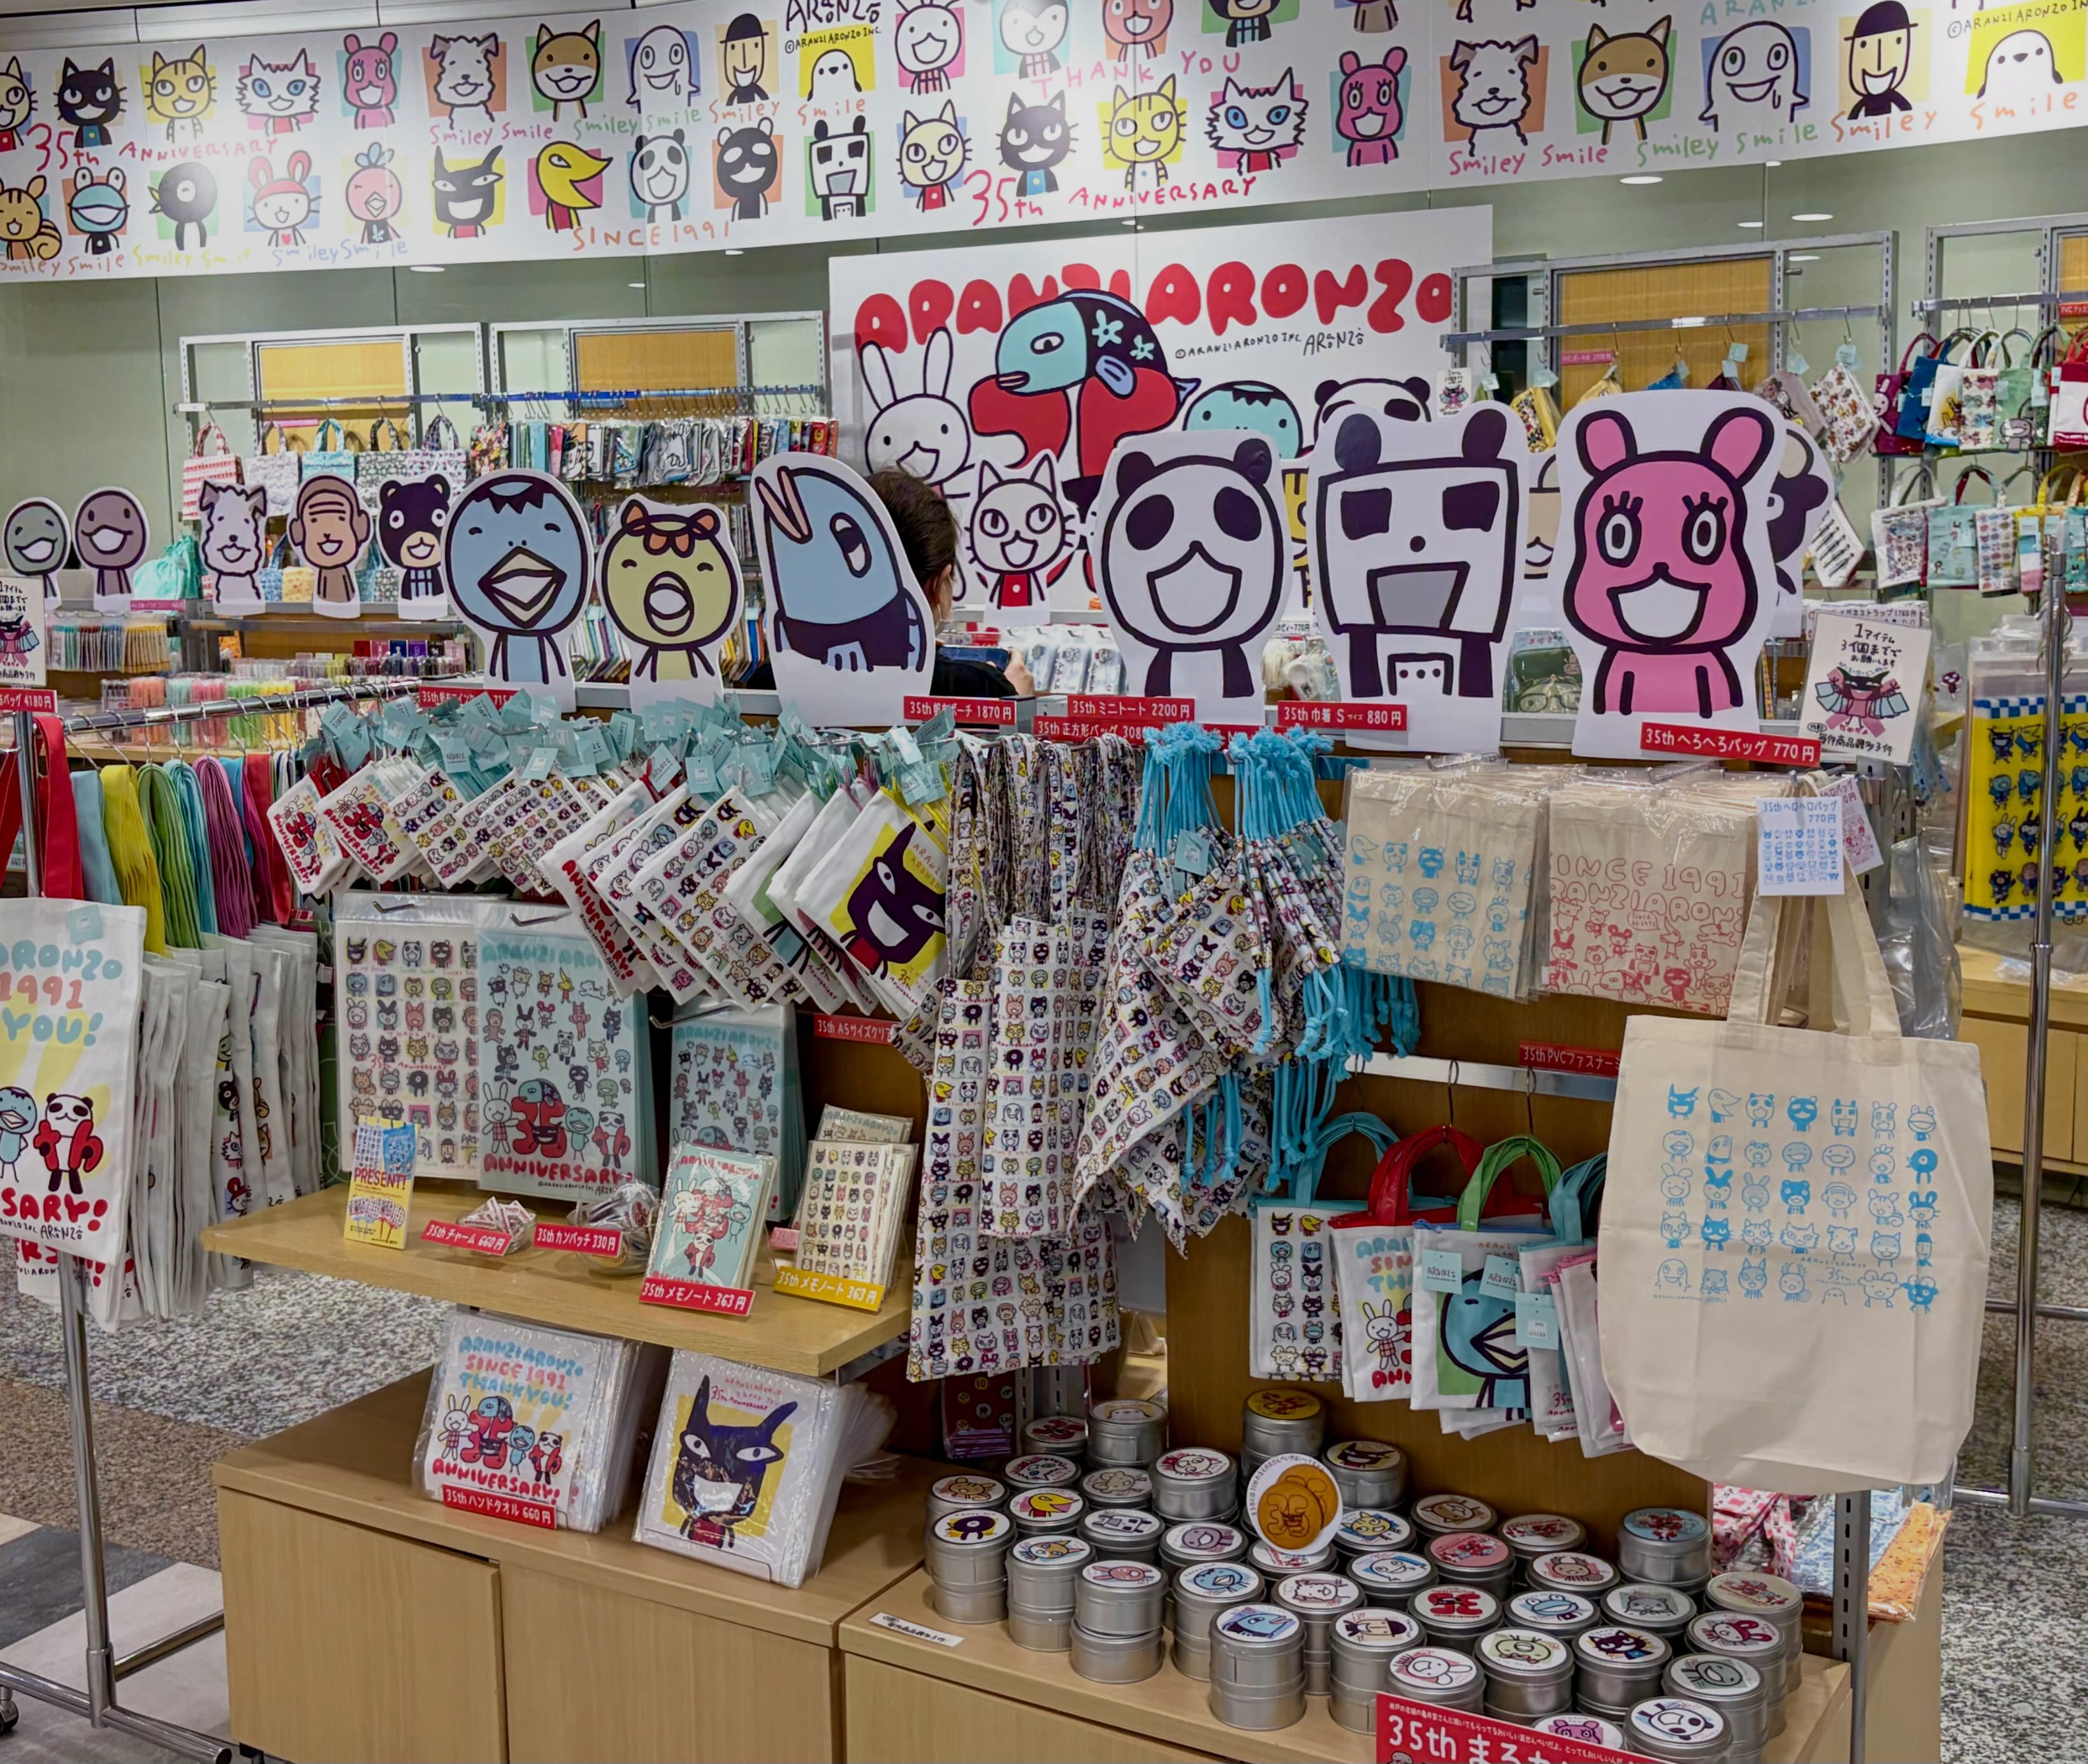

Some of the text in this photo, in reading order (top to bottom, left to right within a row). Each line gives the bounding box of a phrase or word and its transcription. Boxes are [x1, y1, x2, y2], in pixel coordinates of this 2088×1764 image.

[1031, 64, 1154, 99] THANK
[574, 107, 702, 140] Smiley Smile
[709, 98, 866, 126] Smiley Smile
[1831, 91, 2077, 142] Smiley Smile
[430, 122, 553, 146] Smiley Smile
[1637, 121, 1818, 167] Smiley Smile
[26, 123, 278, 172] 35th ANNIVERSARY
[1449, 145, 1608, 177] Smiley Smile
[964, 170, 1256, 226] 35th ANNIVERSARY
[68, 254, 125, 275] Smile
[910, 701, 931, 716] 35th
[1073, 700, 1096, 714] 35th
[1099, 701, 1146, 716] ミニトート
[1284, 706, 1309, 721] 35th
[1038, 721, 1060, 735] 35th
[1646, 728, 1675, 746] 35th
[3, 1008, 103, 1047] YOU!
[818, 1020, 835, 1034] 35th
[1524, 1046, 1546, 1063] 35th
[354, 1167, 407, 1190] PRESENT!
[426, 1224, 446, 1238] 35th
[537, 1227, 555, 1242] 35th
[642, 1282, 664, 1298] 35th
[777, 1271, 799, 1287] 35th
[460, 1371, 525, 1398] THANK
[466, 1354, 566, 1390] SINCE 1991
[433, 1457, 561, 1506] ANNIVERSARY!
[446, 1489, 467, 1505] 35th
[468, 1493, 520, 1517] ハンドタオル
[1389, 1715, 1456, 1760] 35th
